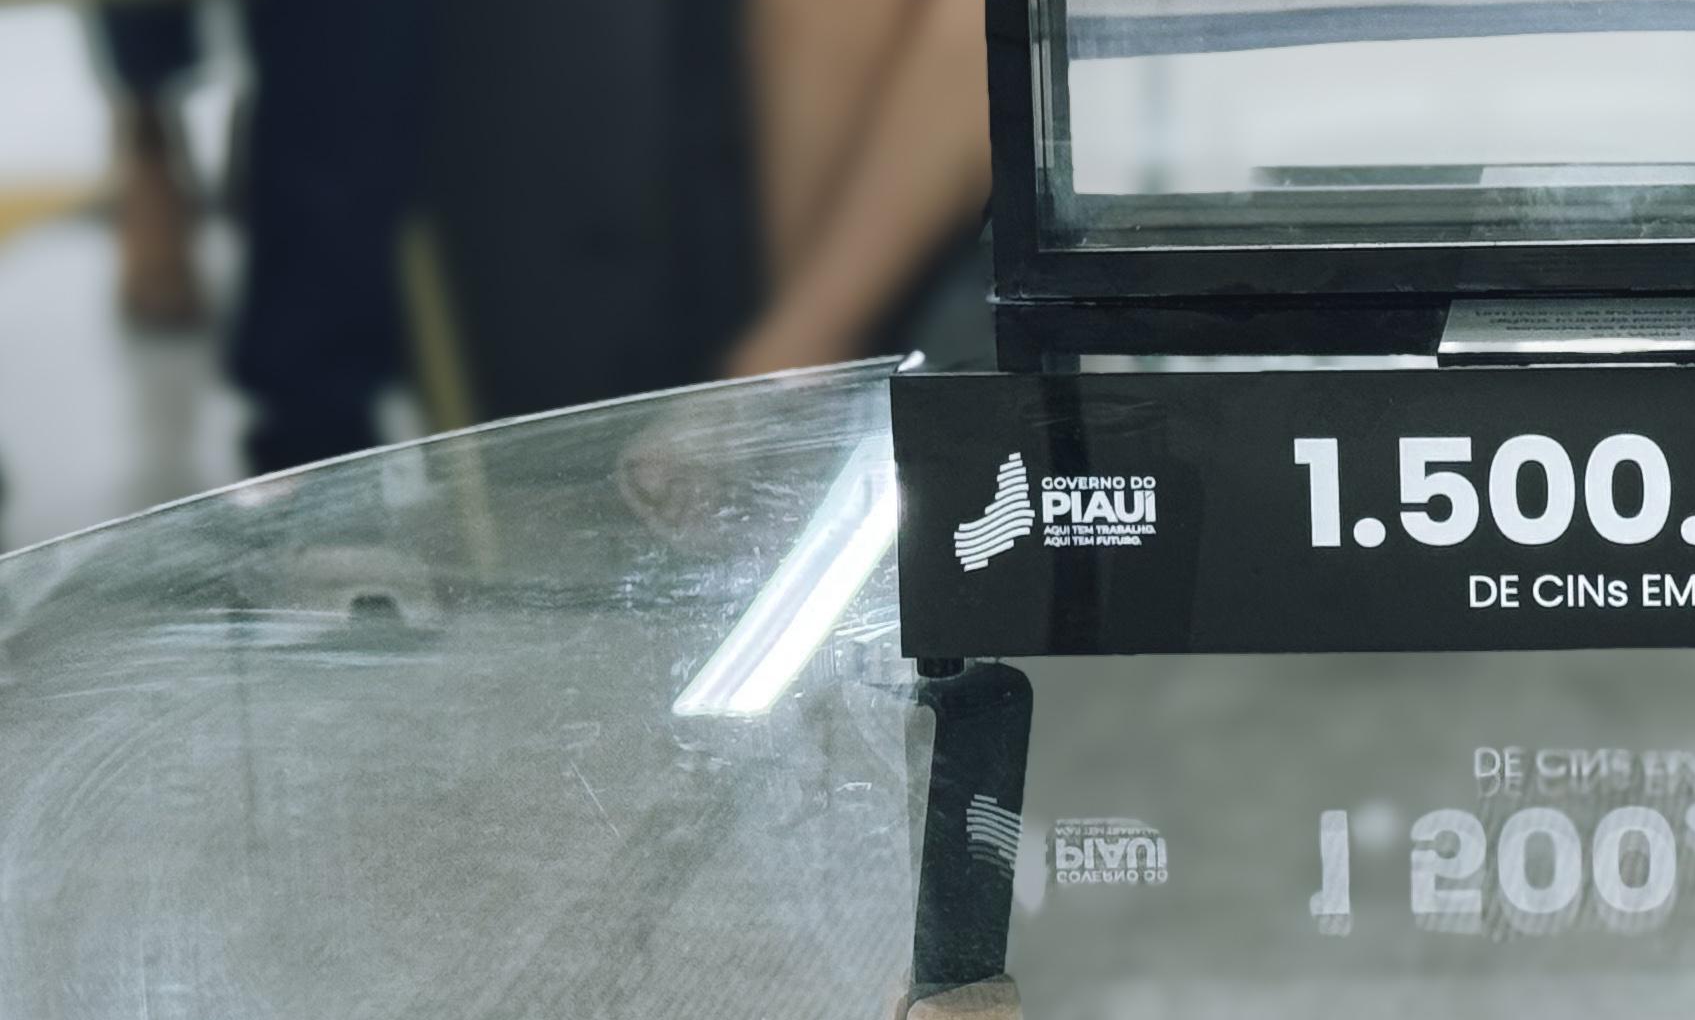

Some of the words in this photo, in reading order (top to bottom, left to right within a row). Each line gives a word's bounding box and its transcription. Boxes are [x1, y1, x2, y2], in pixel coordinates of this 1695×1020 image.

[1041, 476, 1126, 490] GOVERNO
[1130, 476, 1156, 490] DO
[1044, 525, 1071, 536] AQUI
[1072, 525, 1094, 534] TEM
[1044, 536, 1071, 547] AQUI
[1072, 536, 1094, 545] TEM
[1469, 574, 1520, 608] DE
[1532, 574, 1629, 608] CINs
